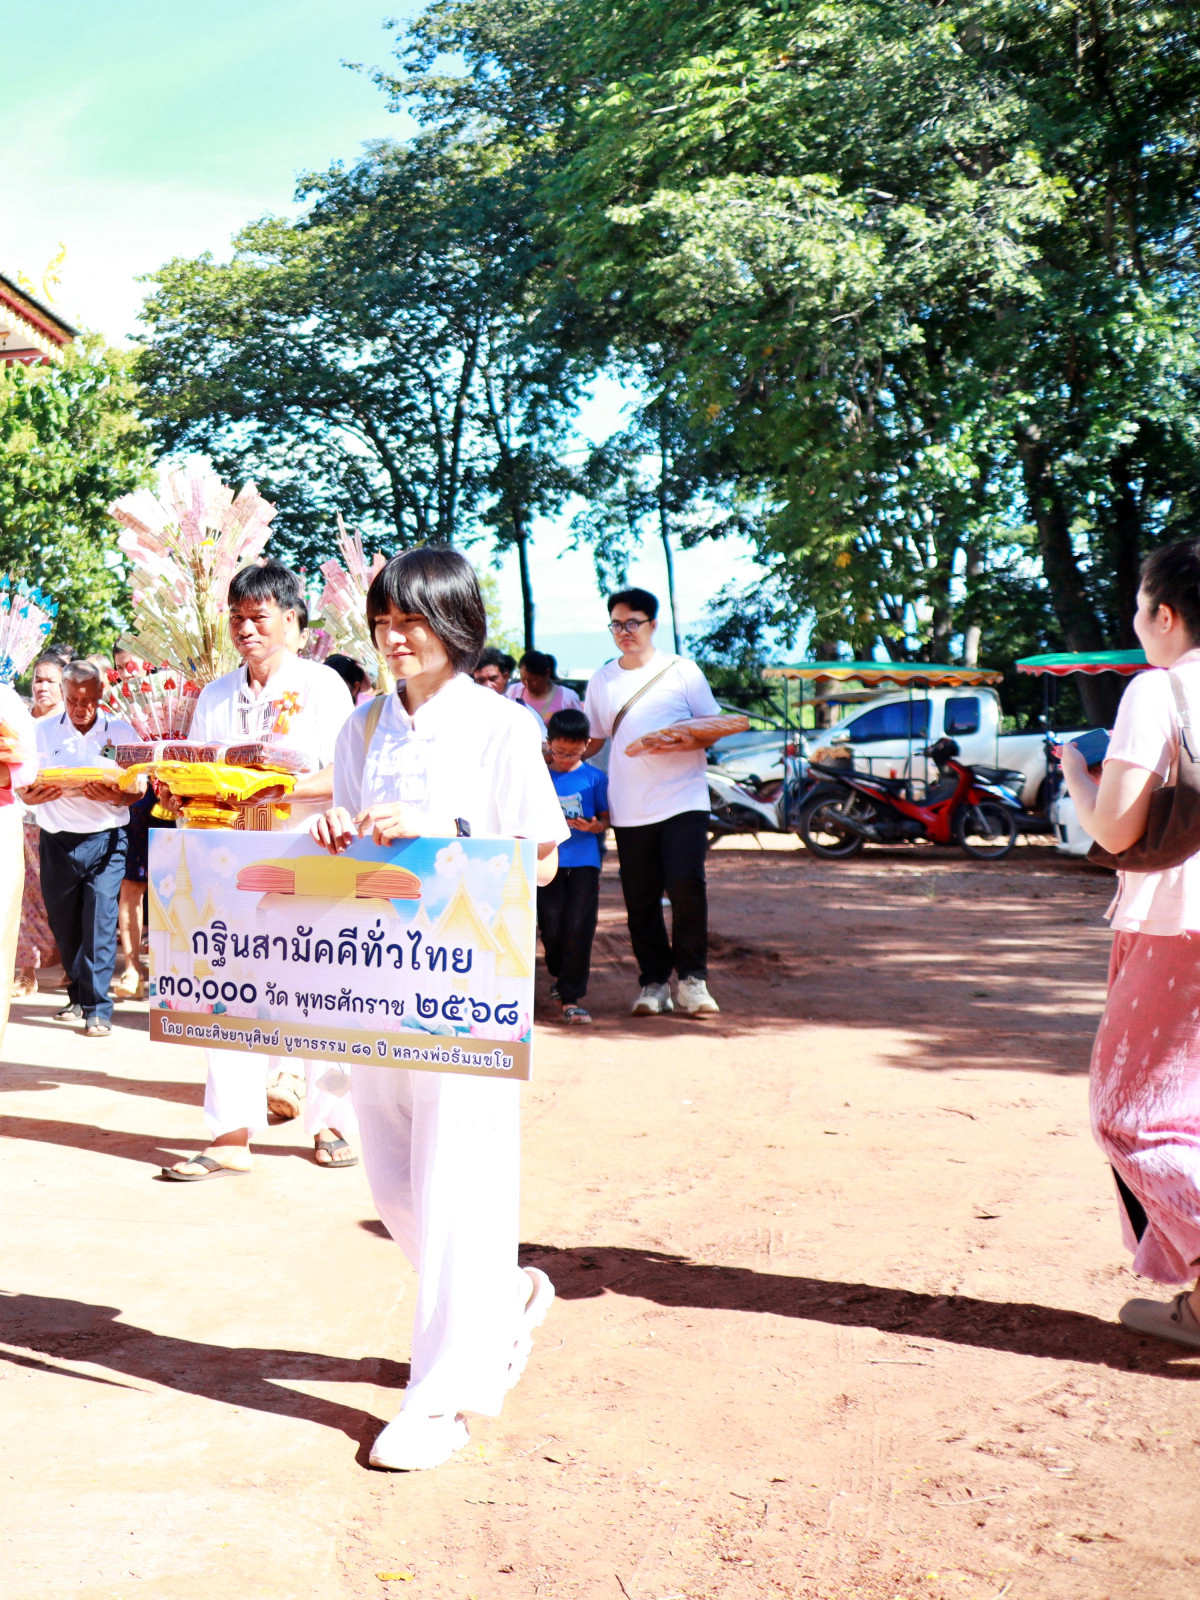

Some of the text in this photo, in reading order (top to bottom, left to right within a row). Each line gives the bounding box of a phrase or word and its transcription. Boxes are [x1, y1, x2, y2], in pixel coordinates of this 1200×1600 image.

[192, 919, 473, 974] กฐินสามัคคีทั่วไทย
[159, 975, 519, 1026] ๓๐,๐๐๐ วัด พุทธศักราช ๒๕๖๘
[161, 1018, 513, 1069] โดย คณะศิษยานุศิษย์ บูชาธรรม ๘๑ ปี หลวงพ่อธัมมชโย
